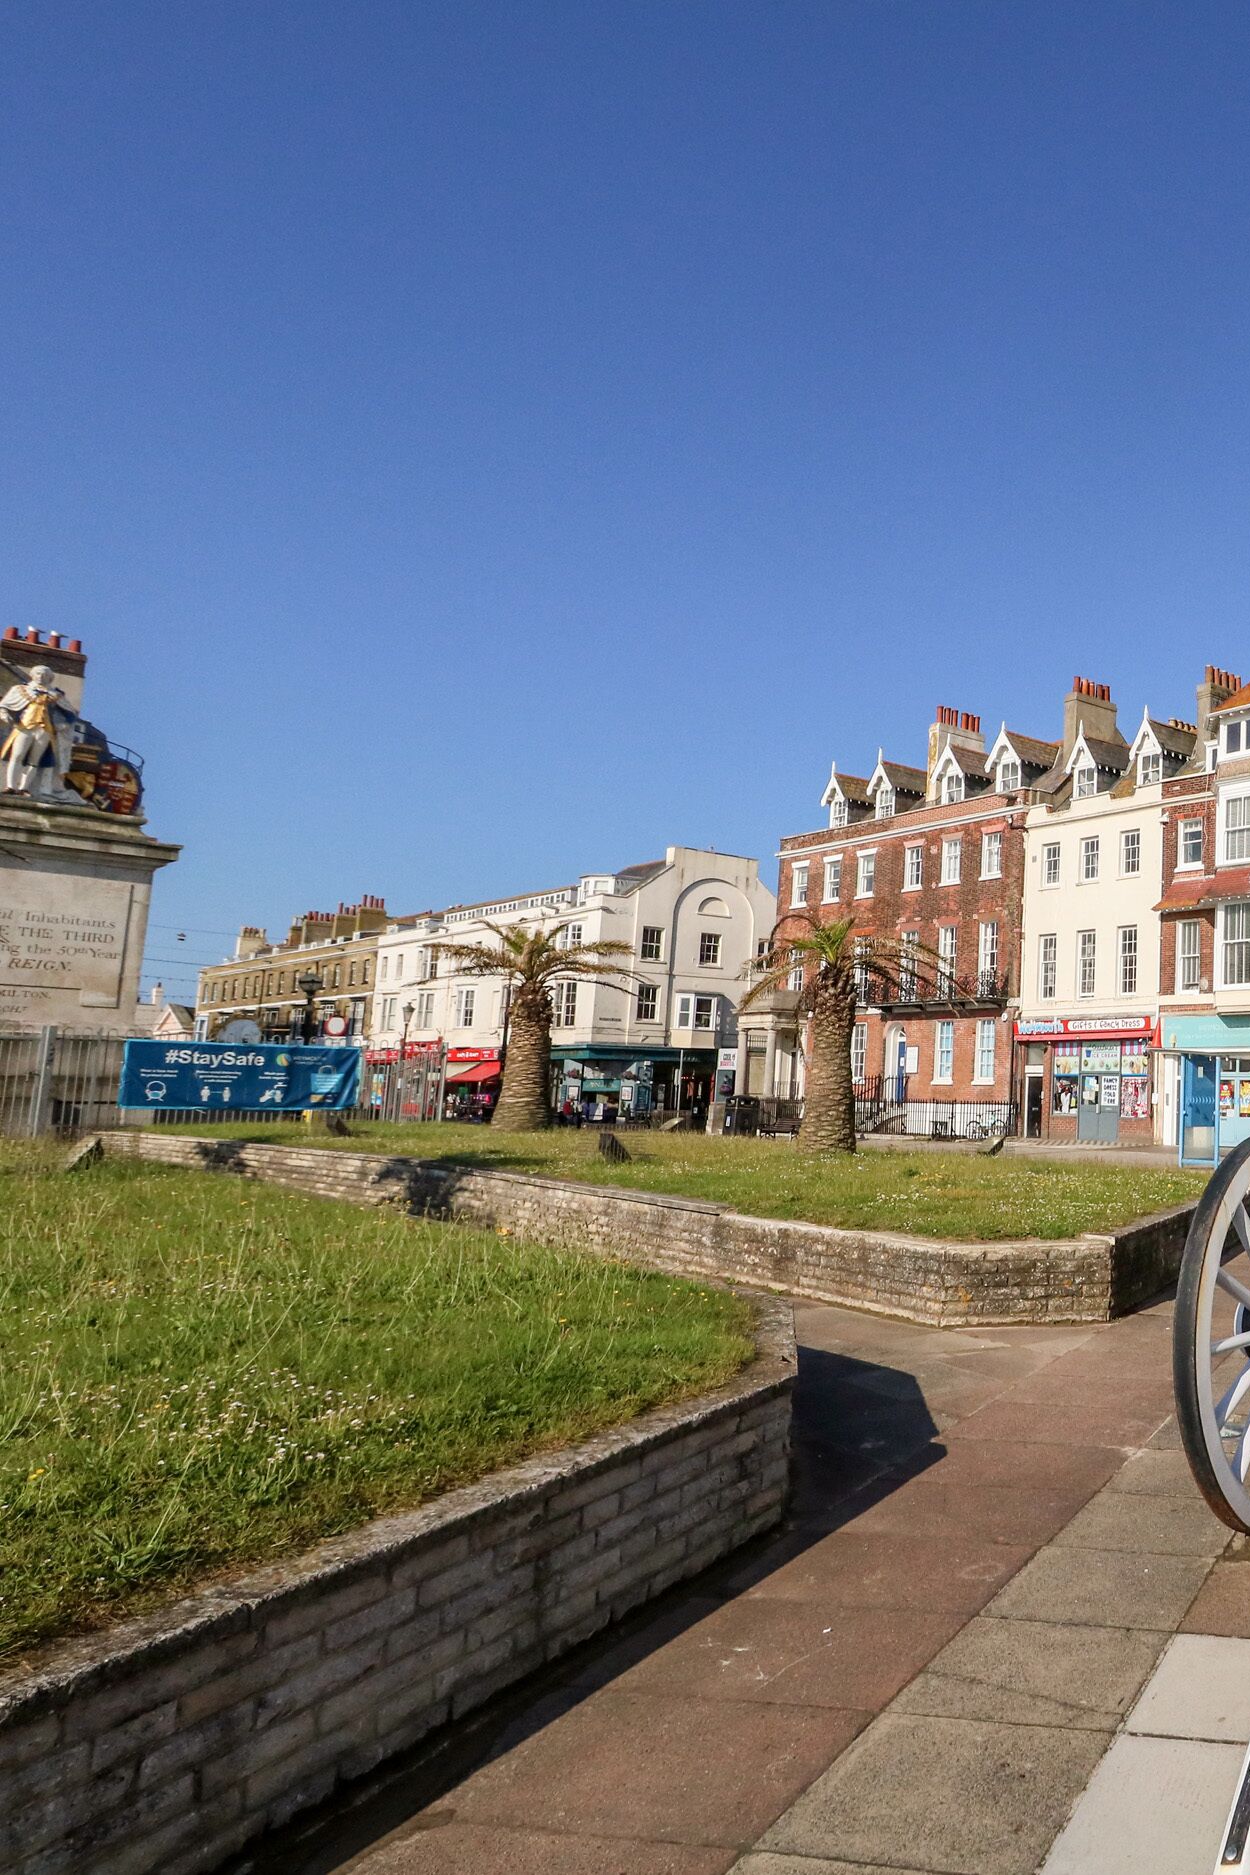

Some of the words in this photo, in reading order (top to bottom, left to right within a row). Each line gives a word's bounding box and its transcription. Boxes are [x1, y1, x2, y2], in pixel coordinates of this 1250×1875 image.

[26, 911, 116, 928] Inhabitants
[19, 926, 54, 940] THE
[63, 930, 115, 944] THIRD
[27, 944, 52, 955] the
[89, 947, 120, 960] Year
[165, 1049, 266, 1068] #StaySafe
